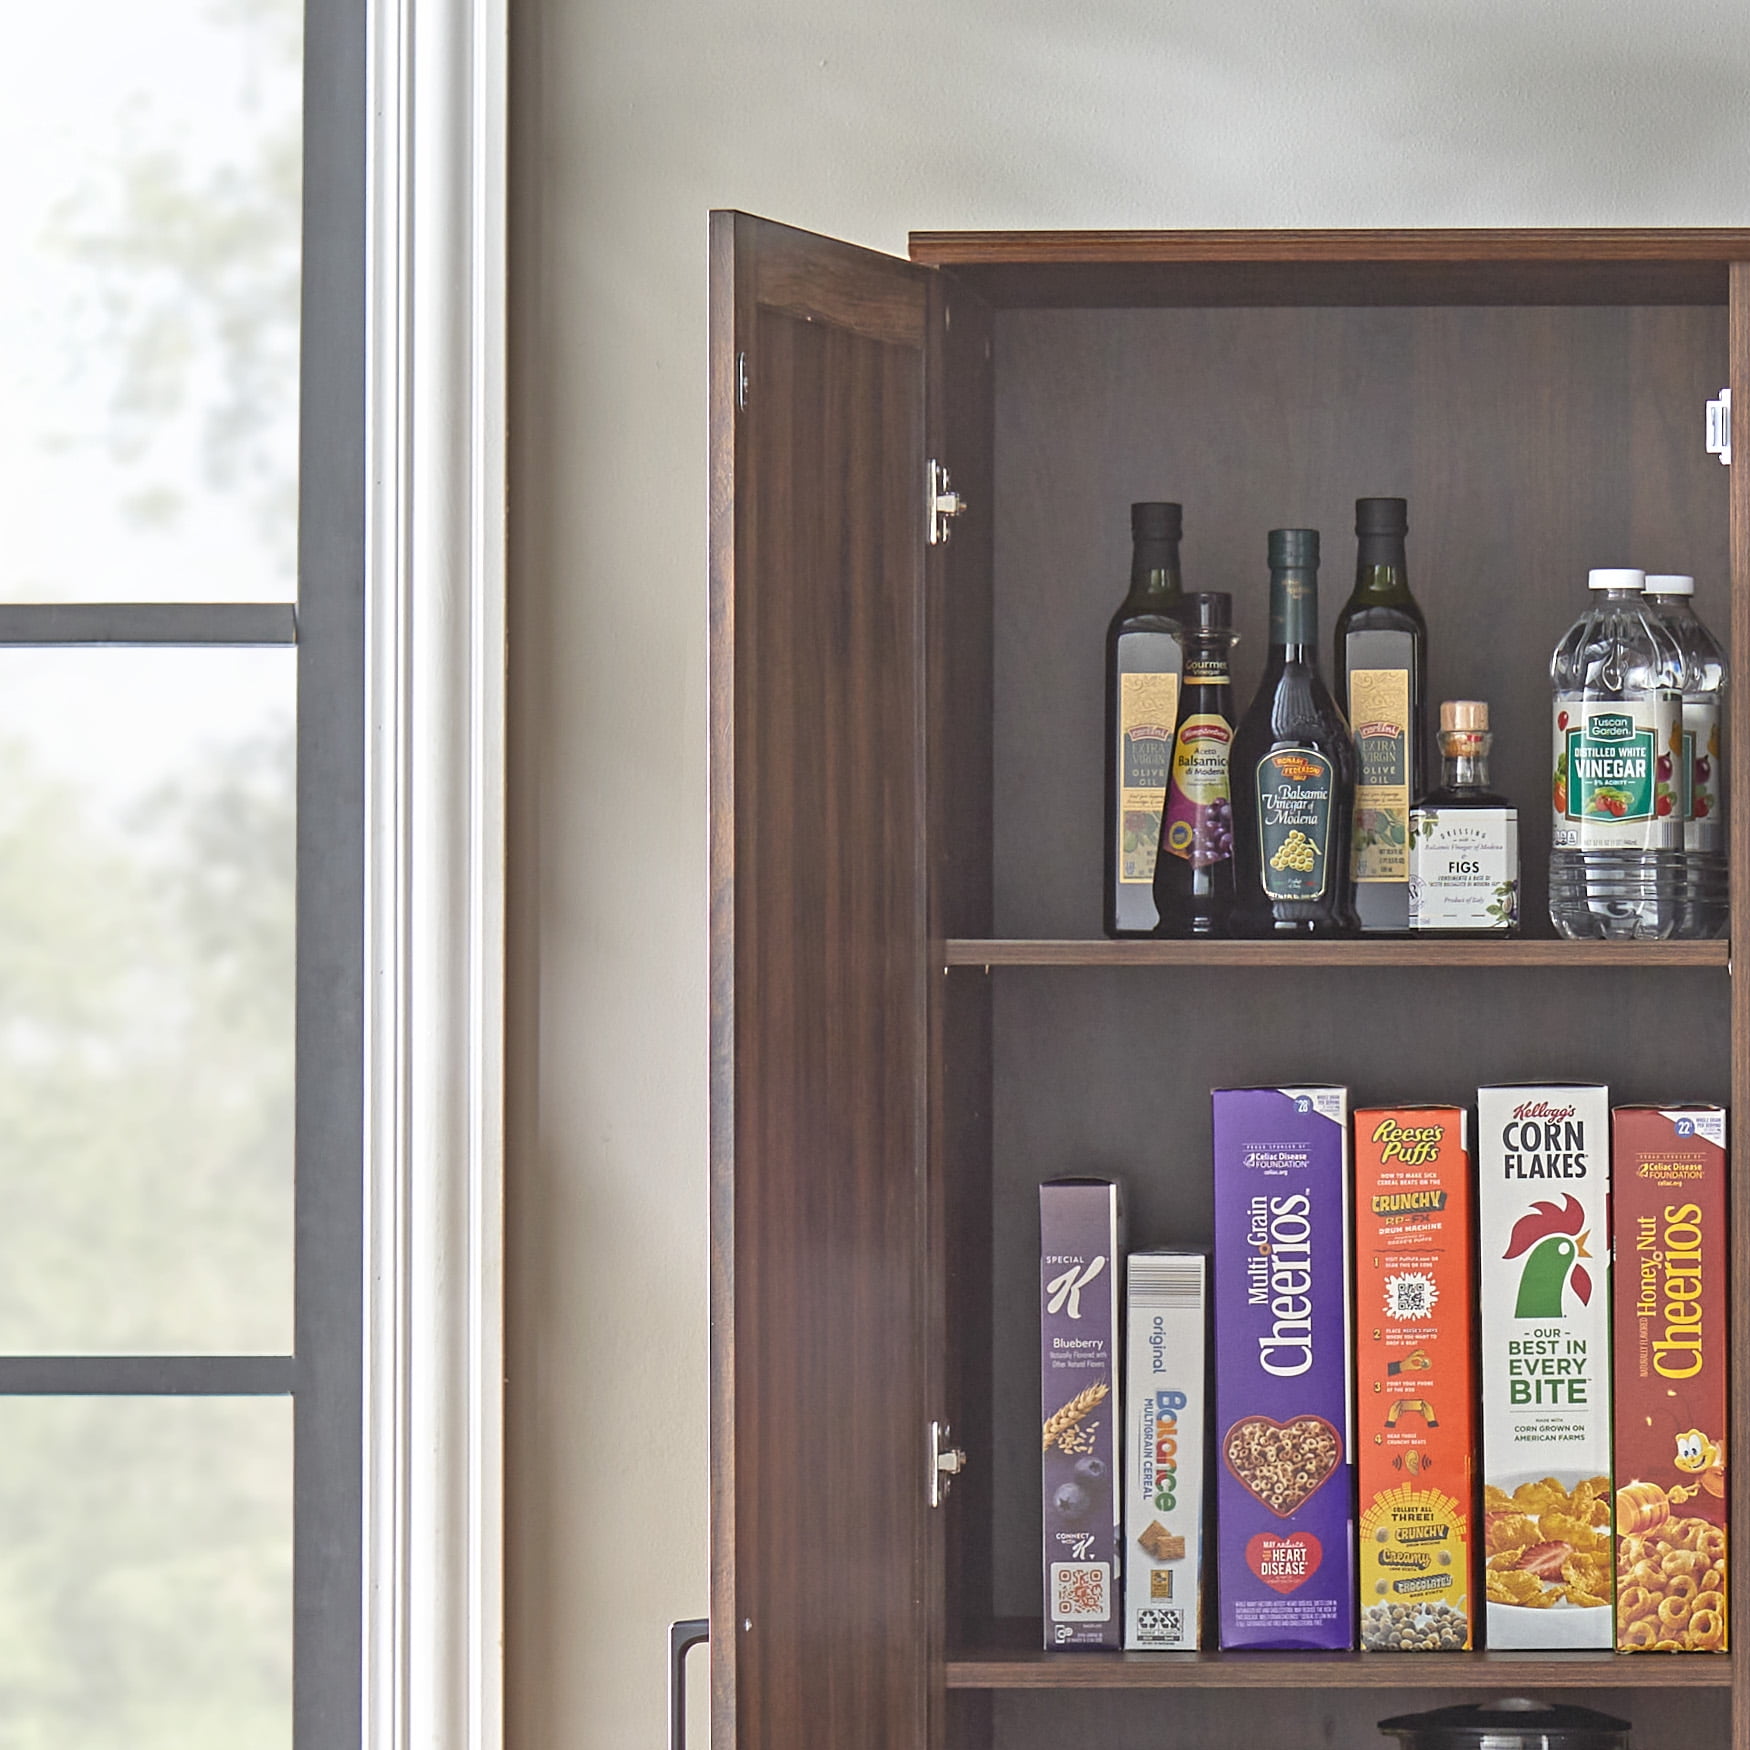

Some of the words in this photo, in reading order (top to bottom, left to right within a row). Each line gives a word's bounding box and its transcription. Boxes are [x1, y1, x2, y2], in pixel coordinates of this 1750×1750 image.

[1593, 717, 1627, 726] Tuscan
[1592, 727, 1629, 736] Garden
[1362, 740, 1396, 751] EXTRA
[1574, 748, 1616, 757] DISTILLED
[1618, 748, 1646, 757] WHITE
[1362, 751, 1396, 762] VIRGIN
[1132, 769, 1165, 777] OLIVE
[1195, 767, 1224, 776] Modena
[1362, 766, 1396, 775] OLIVE
[1575, 760, 1646, 778] VINEGAR
[1139, 778, 1157, 786] OIL
[1370, 776, 1389, 785] OIL
[1278, 784, 1328, 801] Balsamic
[1262, 793, 1306, 814] Vinegar
[1265, 809, 1318, 825] Modena
[1449, 861, 1479, 873] FIGS
[1513, 1101, 1576, 1123] Kellogg's
[1373, 1119, 1445, 1143] Reese's
[1678, 1121, 1690, 1134] 22
[1503, 1121, 1584, 1152] CORN
[1256, 1152, 1278, 1160] Celiac
[1279, 1152, 1307, 1160] Disease
[1381, 1142, 1440, 1165] Puffs
[1504, 1154, 1587, 1179] FLAKES
[1649, 1163, 1672, 1171] Celiac
[1673, 1163, 1702, 1171] Disease
[1649, 1171, 1703, 1179] FOUNDATION
[1372, 1190, 1442, 1213] CRUNCHY
[1247, 1196, 1268, 1246] Grain
[1379, 1226, 1403, 1235] DRUM
[1405, 1223, 1442, 1232] MACHINE
[1637, 1216, 1657, 1251] Nut
[1046, 1256, 1084, 1264] SPECIAL
[1046, 1255, 1106, 1319] K
[1247, 1257, 1268, 1304] Multi
[1259, 1194, 1313, 1377] Cheerios
[1637, 1257, 1662, 1317] Honey
[1652, 1203, 1703, 1379] Cheerios
[1534, 1329, 1561, 1338] OUR
[1053, 1338, 1103, 1350] Blueberry
[1149, 1316, 1166, 1373] original
[1509, 1340, 1559, 1355] BEST
[1567, 1340, 1586, 1354] IN
[1509, 1358, 1587, 1375] EVERY
[1510, 1379, 1587, 1404] BITE
[1143, 1398, 1153, 1459] MULTIGRAIN
[1155, 1390, 1187, 1512] Balance
[1143, 1460, 1152, 1500] CEREAL
[1056, 1532, 1089, 1540] CONNECT
[1395, 1525, 1445, 1541] CRUNCHY
[1072, 1536, 1095, 1560] K
[1273, 1549, 1307, 1561] HEART
[1261, 1562, 1305, 1575] DISEASE
